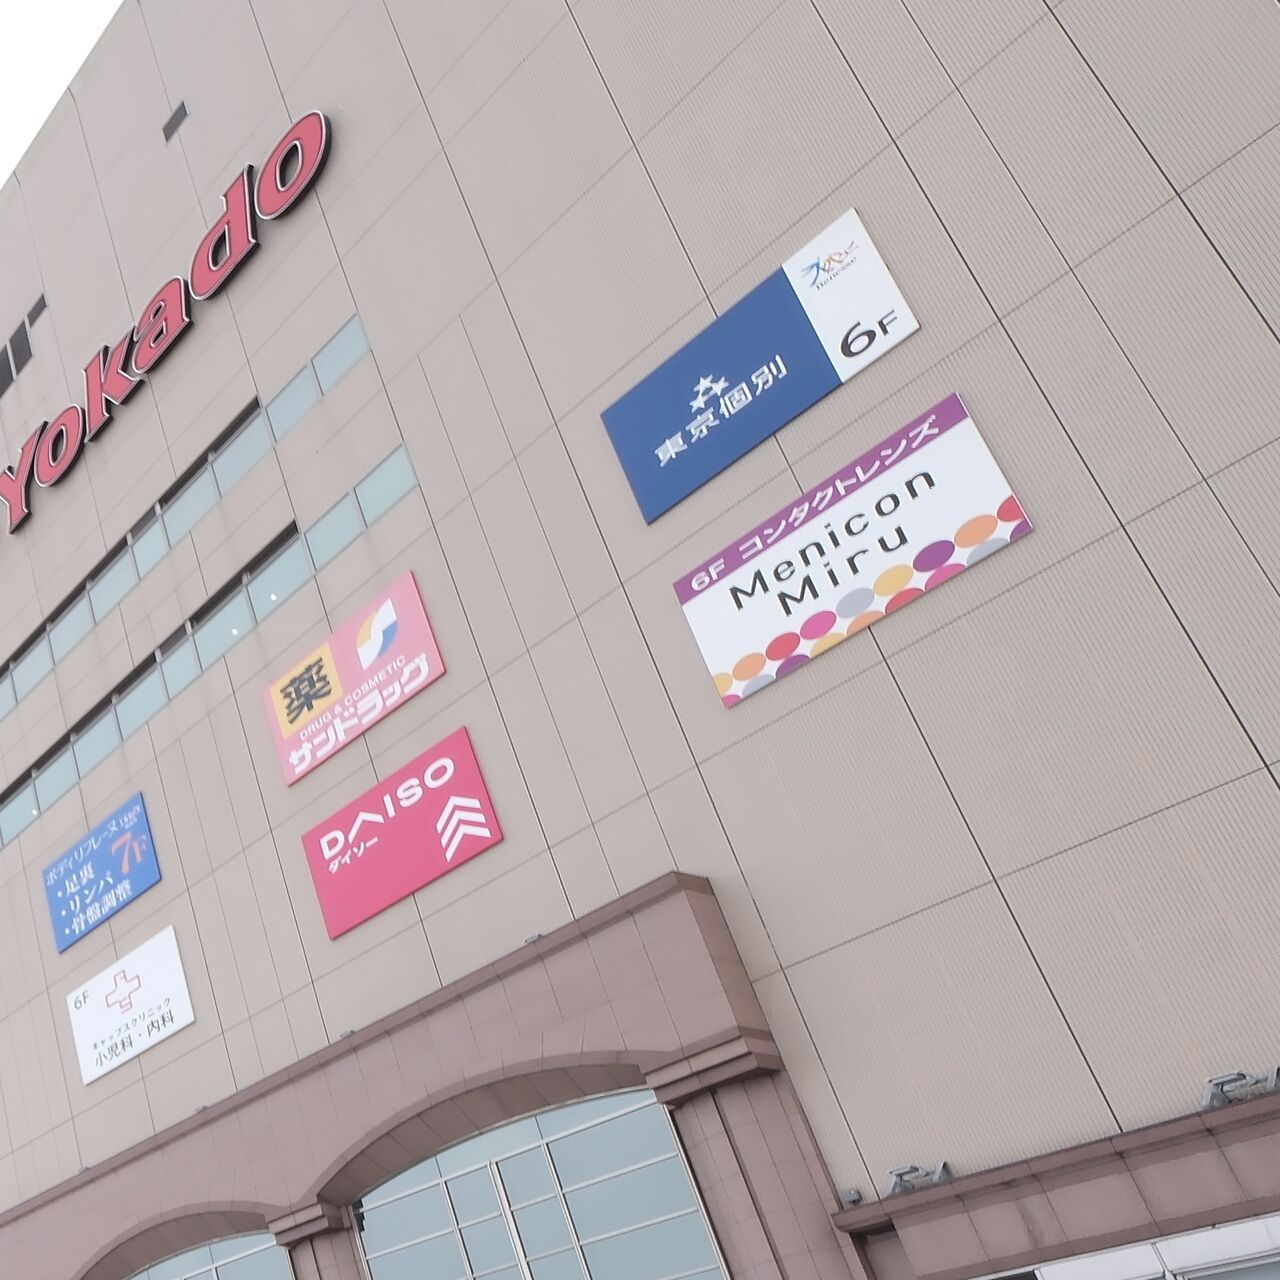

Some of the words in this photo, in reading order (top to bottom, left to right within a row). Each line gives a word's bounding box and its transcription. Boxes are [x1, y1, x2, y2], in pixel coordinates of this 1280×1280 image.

[840, 309, 898, 358] 6F
[653, 353, 789, 467] 東京個別
[689, 561, 729, 592] 6F
[738, 414, 941, 555] コンタクトレンズ
[728, 469, 936, 612] Menicon
[777, 525, 911, 618] Miru
[279, 656, 333, 726] 薬
[288, 652, 430, 776] サンドラッグ
[300, 714, 333, 741] DRUG
[344, 654, 407, 708] COSMETIC
[319, 756, 455, 861] DAISO
[327, 836, 380, 875] ダイソー
[74, 990, 90, 1011] 6F
[95, 1009, 175, 1067] 小児科・内科
